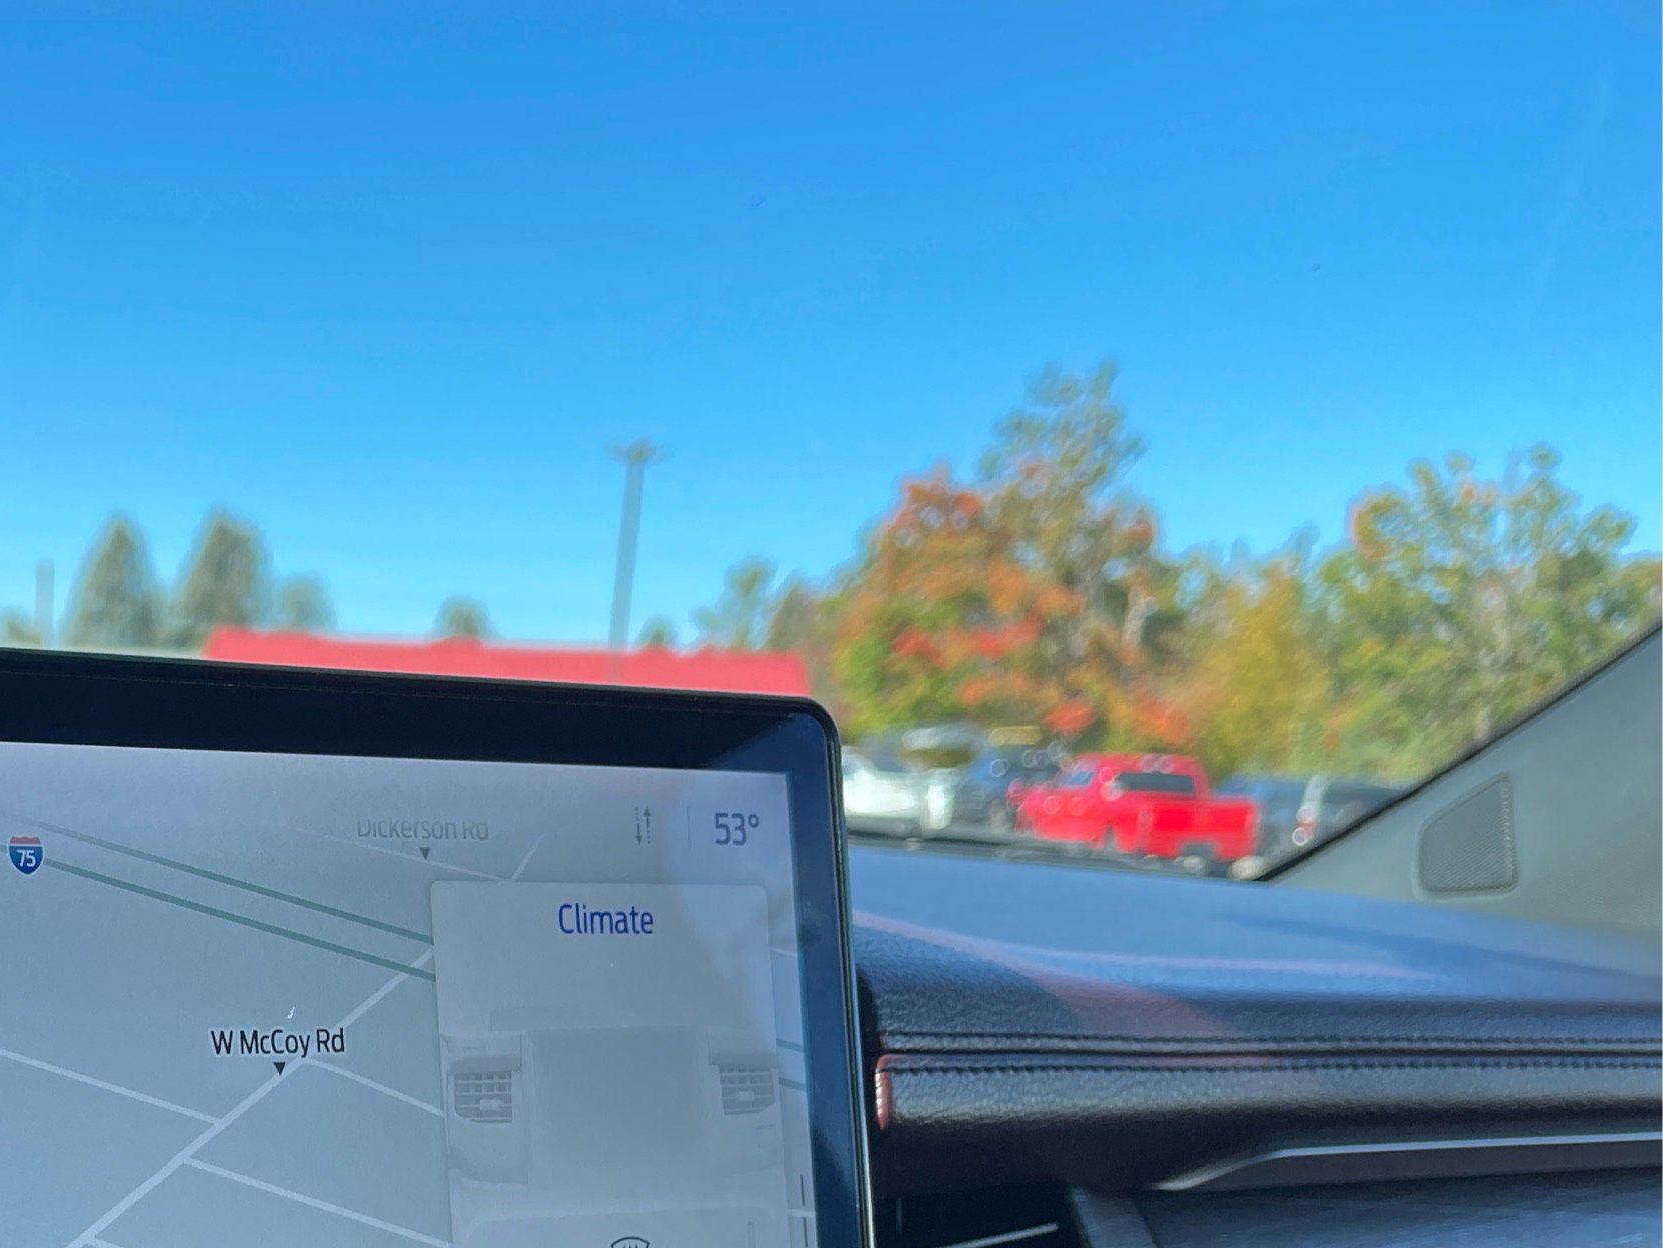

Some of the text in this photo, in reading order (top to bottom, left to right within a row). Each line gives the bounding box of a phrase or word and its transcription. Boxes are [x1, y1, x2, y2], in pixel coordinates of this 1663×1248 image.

[714, 813, 760, 845] 53°
[17, 850, 36, 867] 75
[558, 903, 654, 934] Climate
[211, 1027, 346, 1058] W McCoy Rd
